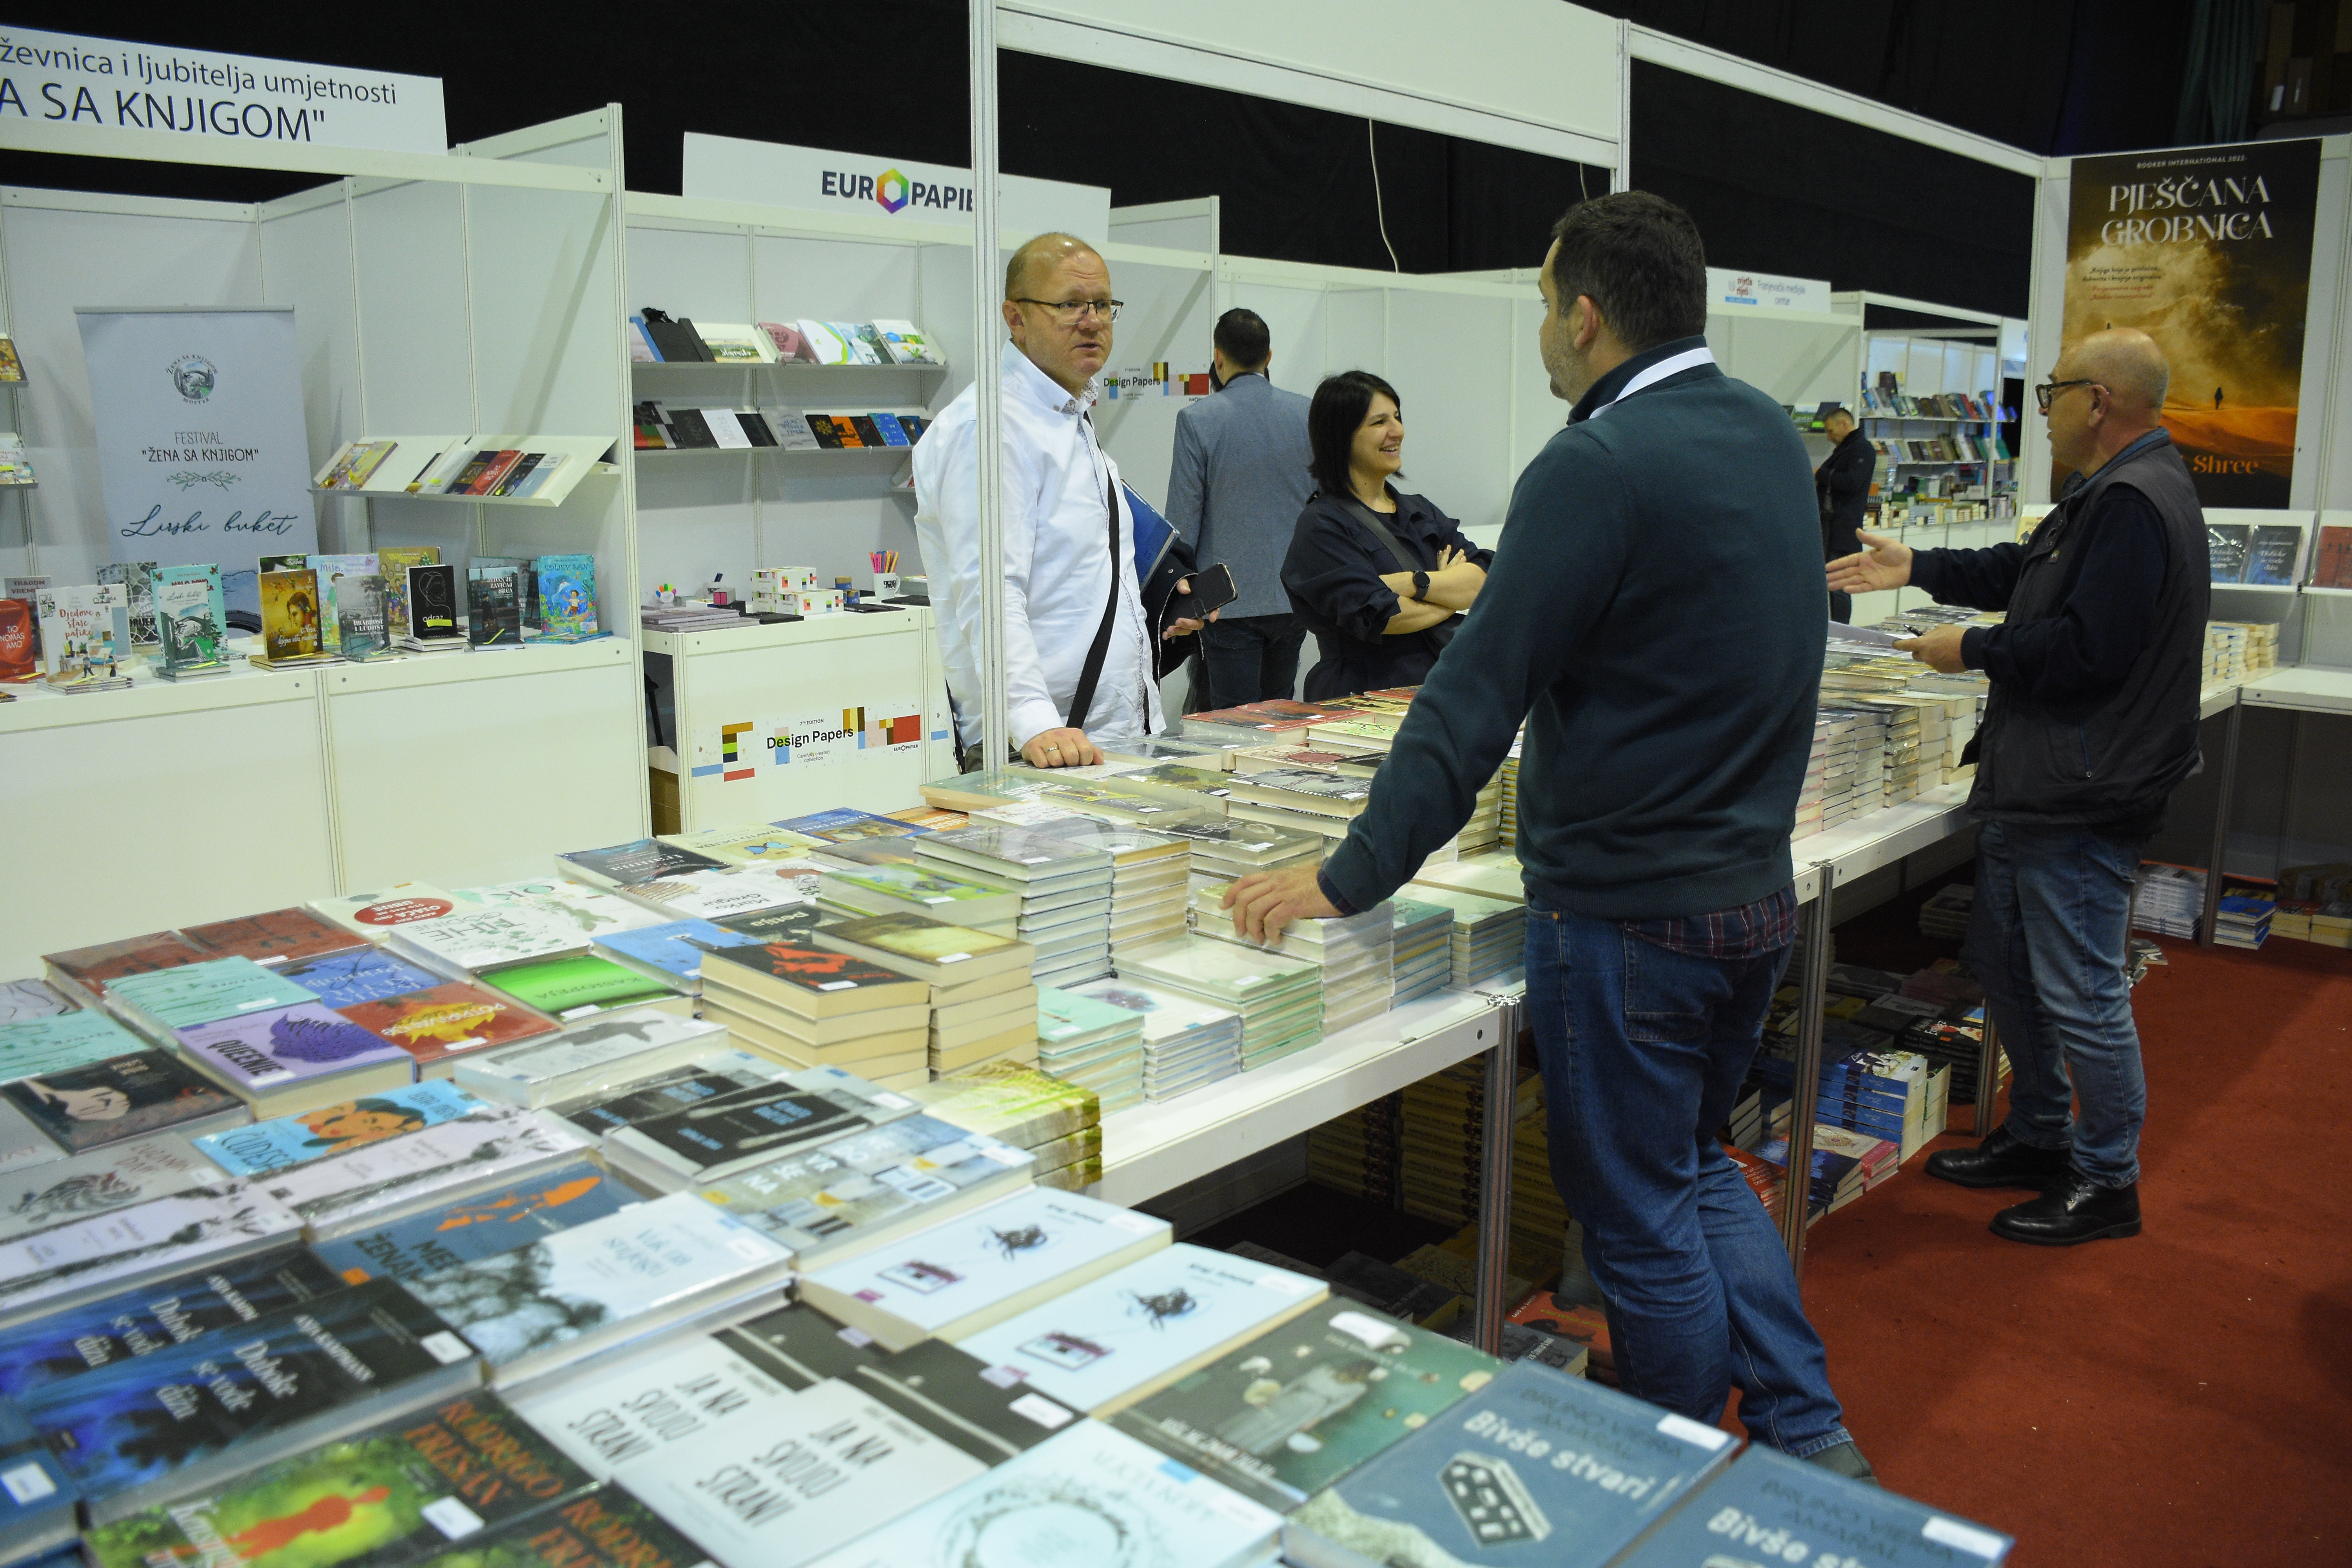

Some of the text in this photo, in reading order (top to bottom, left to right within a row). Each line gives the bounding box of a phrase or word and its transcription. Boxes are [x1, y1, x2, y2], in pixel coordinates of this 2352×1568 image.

[0, 38, 397, 105] ževnica i ljubitelja umjetnosti
[44, 83, 102, 123] SA
[116, 93, 326, 142] KNJIGOM"
[2168, 156, 2226, 167] INTERNATIONAL
[2109, 175, 2270, 215] PJEŠČANA
[2102, 211, 2273, 247] GROBNICA
[1104, 377, 1160, 388] Design Papers
[183, 397, 211, 405] MOSTAR
[174, 432, 223, 445] FESTIVAL
[142, 447, 259, 462] "ŽENA SA KNJIGOM"
[2193, 455, 2259, 475] Shree
[224, 511, 298, 535] buket
[60, 609, 93, 621] Djedove
[65, 629, 93, 640] patike
[767, 728, 854, 749] Design Papers
[612, 854, 684, 872] trauma
[370, 899, 414, 912] UBIJE
[394, 905, 441, 919] OJAČA
[699, 893, 763, 907] Gregur
[713, 897, 772, 911] Marko
[407, 912, 503, 932] GODINE
[427, 920, 525, 942] TIHE
[750, 911, 809, 928] petlja
[535, 977, 642, 1001] KASIOPEJA
[207, 1039, 288, 1076] QUEENIE
[738, 1172, 788, 1196] NA
[628, 1227, 678, 1252] Vuk
[593, 1234, 676, 1281] snijegu
[234, 1339, 299, 1398] Duboke
[674, 1372, 715, 1393] JA
[704, 1386, 751, 1418] NA
[622, 1388, 706, 1443] SVOJOJ
[567, 1408, 655, 1466] STRANI
[808, 1417, 859, 1448] JA
[838, 1433, 895, 1469] NA
[436, 1401, 564, 1499] RODRIGO
[1463, 1410, 1653, 1501] Bivše stvari
[751, 1439, 852, 1499] SVOJOJ
[696, 1465, 797, 1528] STRANI
[1707, 1505, 1809, 1565] Bivše
